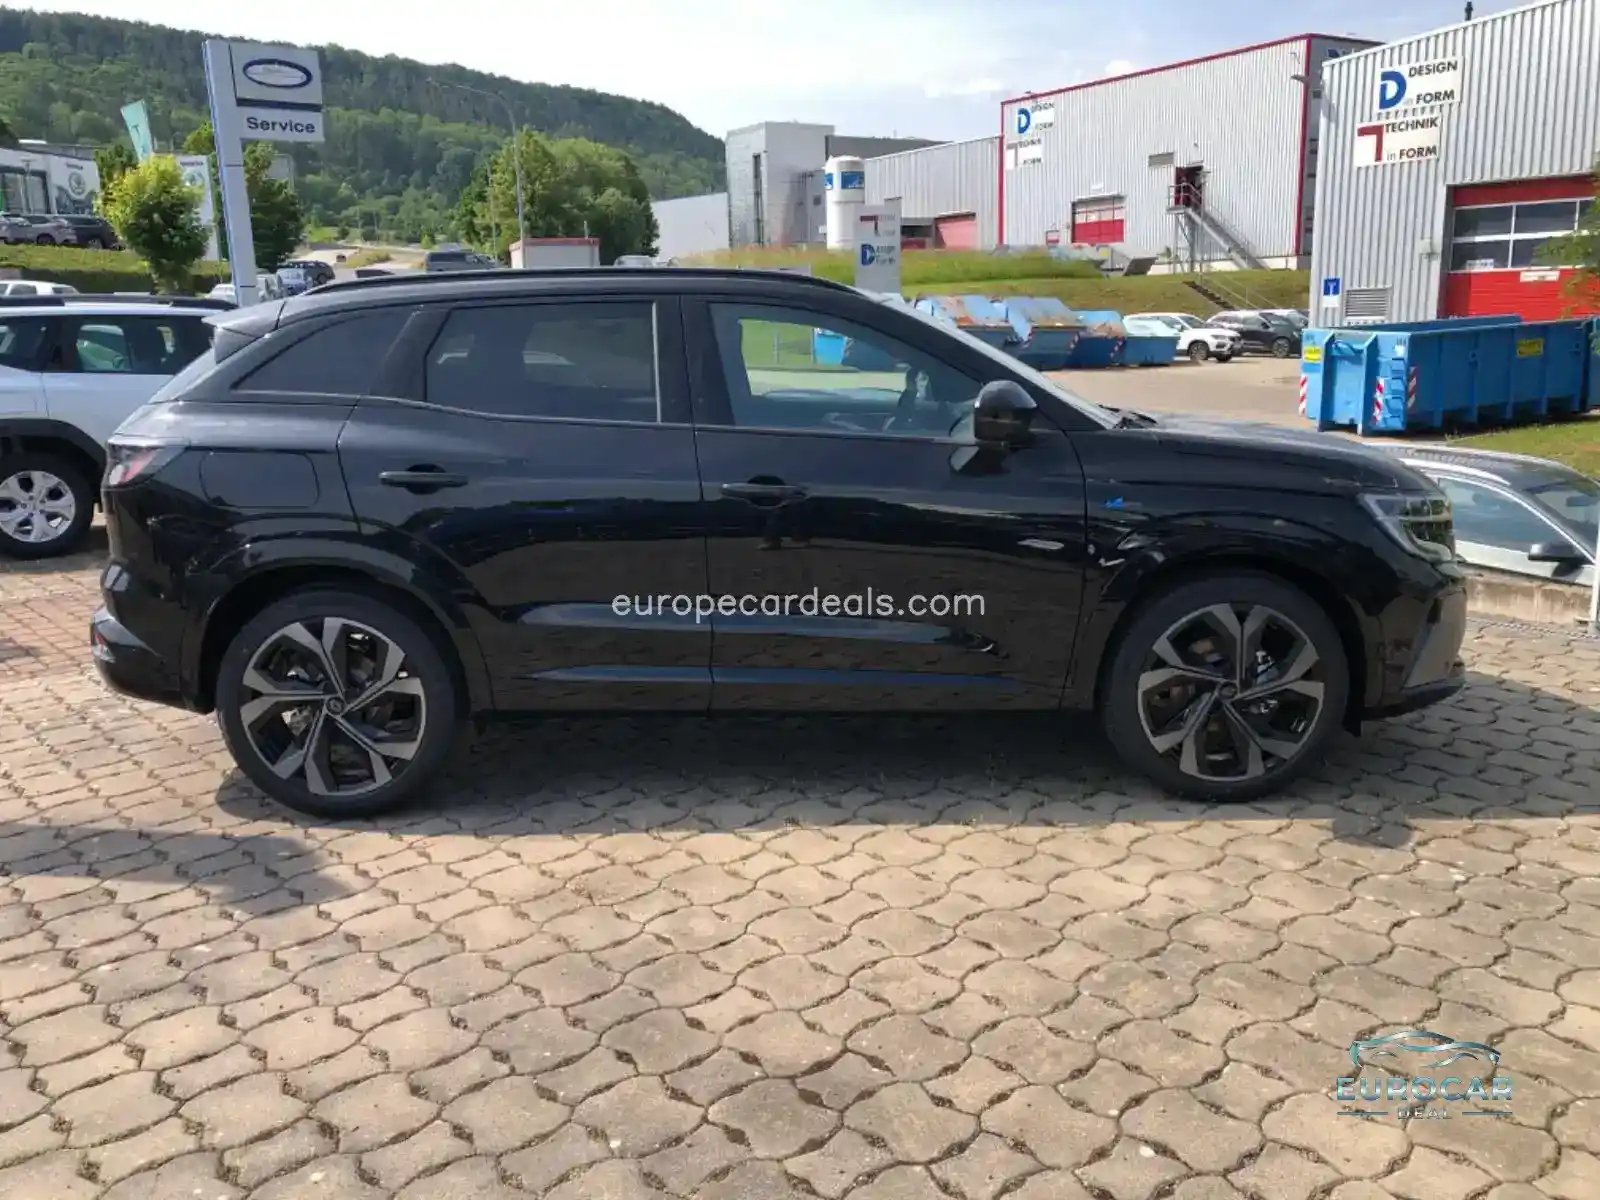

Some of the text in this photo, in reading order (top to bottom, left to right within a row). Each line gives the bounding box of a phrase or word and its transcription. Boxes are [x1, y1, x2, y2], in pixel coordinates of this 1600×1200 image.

[1408, 61, 1458, 77] DESIGN
[1416, 89, 1455, 104] FORM
[246, 116, 316, 134] Service
[1385, 117, 1439, 133] TECHNIK
[1399, 146, 1438, 160] FORM
